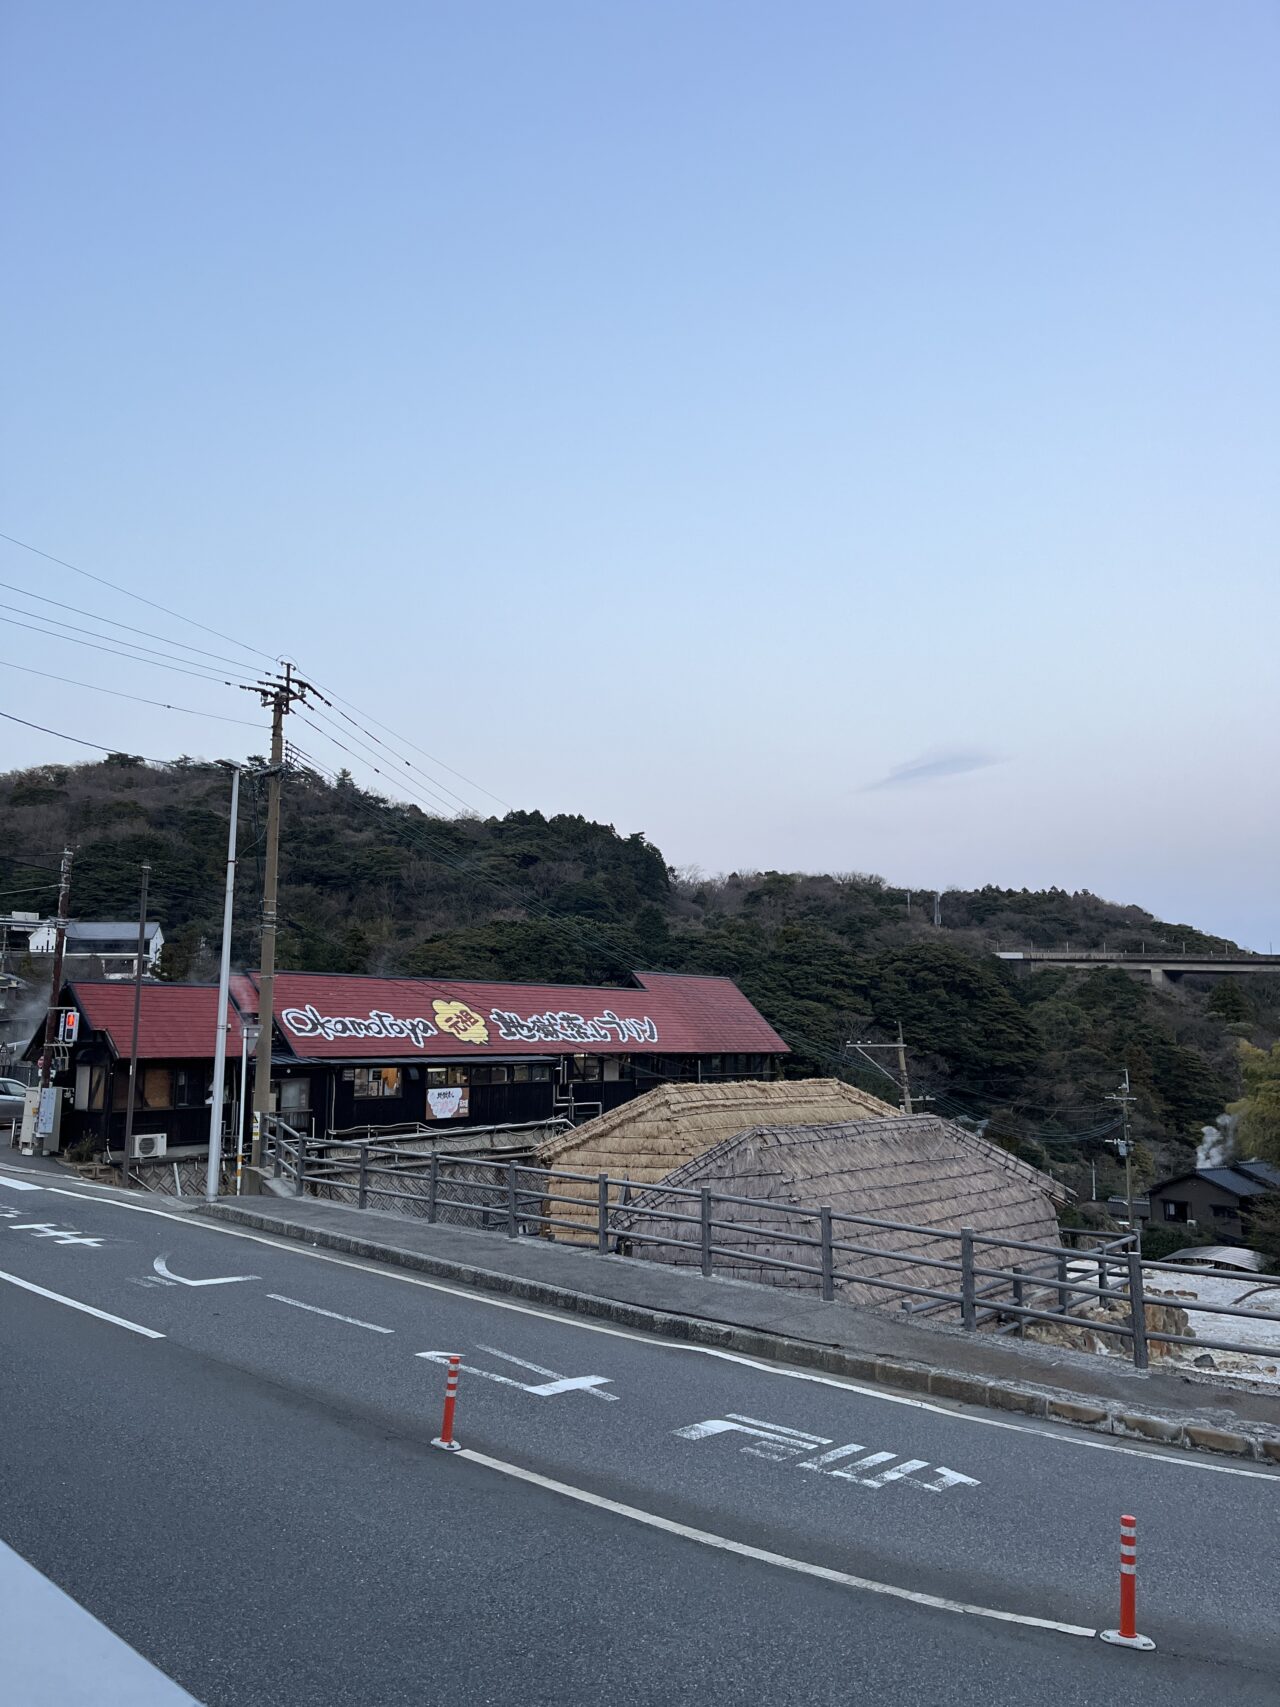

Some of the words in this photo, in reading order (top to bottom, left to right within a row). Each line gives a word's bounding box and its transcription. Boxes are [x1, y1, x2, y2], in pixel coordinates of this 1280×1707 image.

[445, 1010, 479, 1034] 元祖
[490, 1009, 658, 1043] 地獄蒸しプリン
